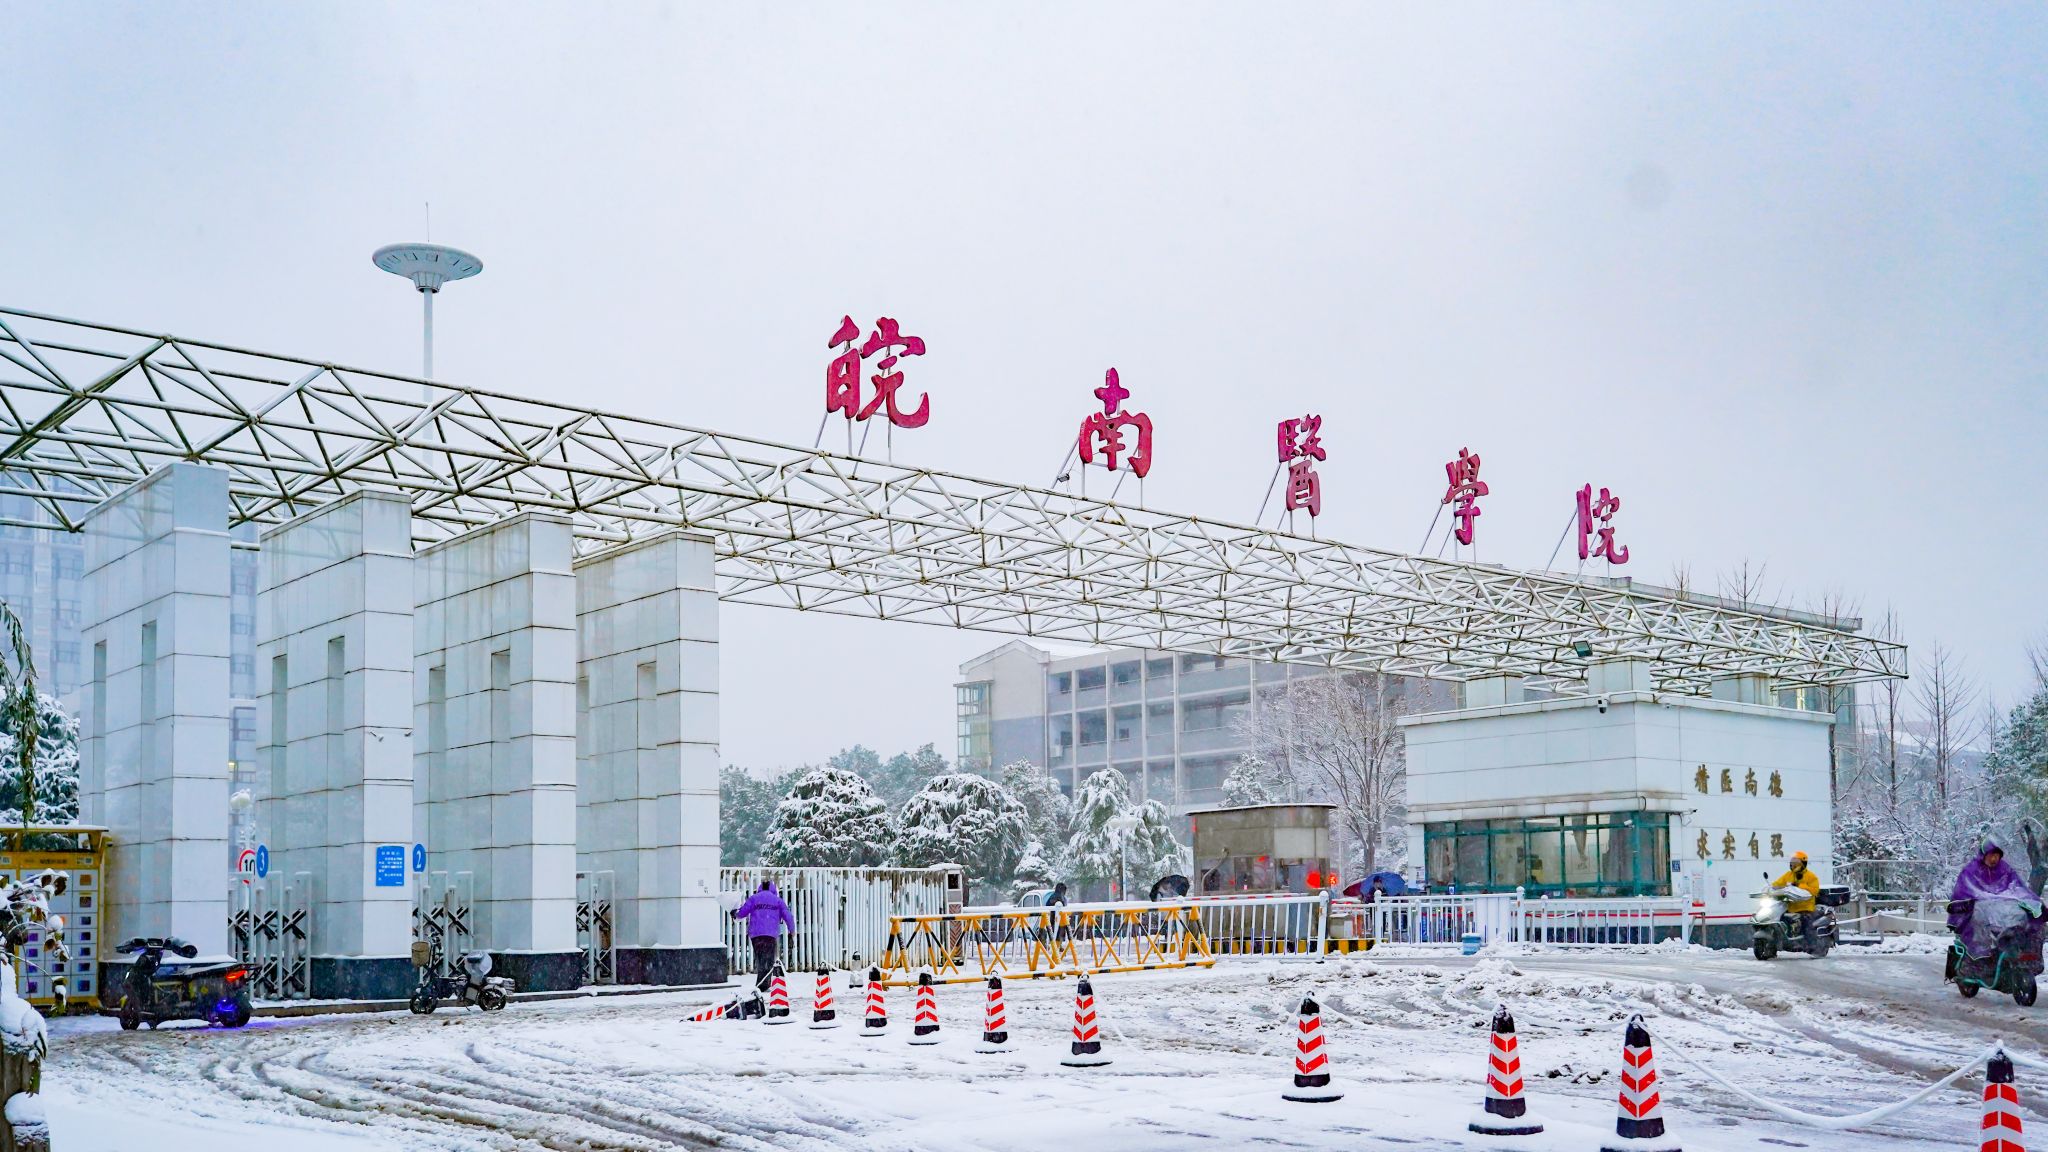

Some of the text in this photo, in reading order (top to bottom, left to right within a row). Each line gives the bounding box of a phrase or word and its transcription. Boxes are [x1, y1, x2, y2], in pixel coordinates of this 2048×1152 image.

[826, 314, 1630, 564] 皖南醫學院
[1694, 764, 1783, 798] 精医尚德
